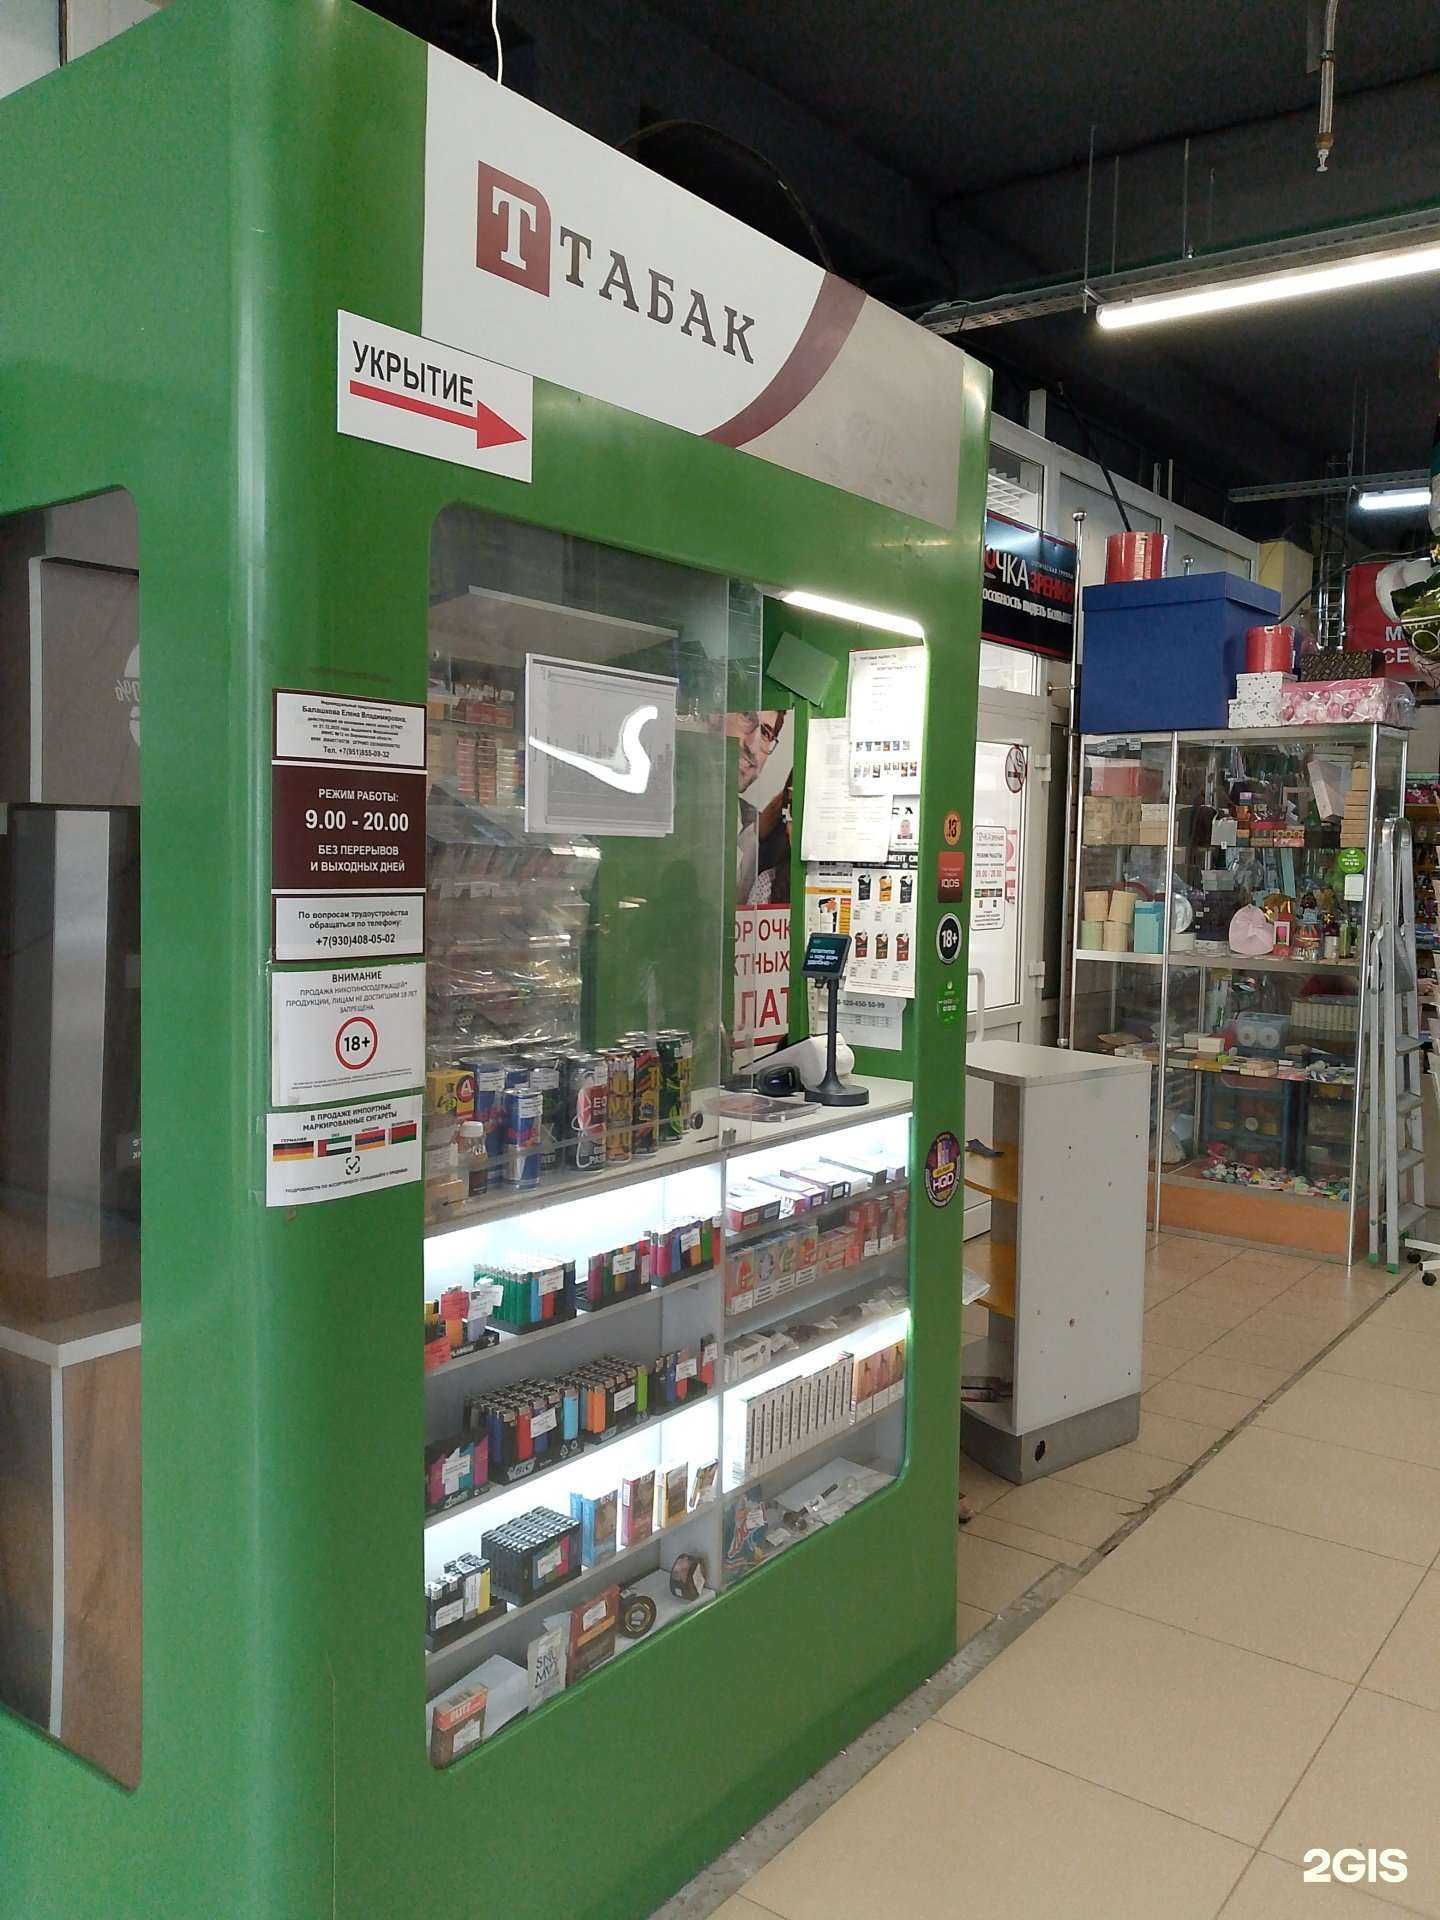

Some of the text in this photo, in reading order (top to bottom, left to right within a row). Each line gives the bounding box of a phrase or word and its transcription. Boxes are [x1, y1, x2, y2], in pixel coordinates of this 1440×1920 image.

[559, 225, 755, 365] ТАБАК
[352, 340, 475, 408] УКРЫТИЕ
[318, 789, 399, 802] РЕЖИМ РАБОТЫ:
[305, 810, 346, 830] 9.00
[363, 812, 409, 831] 20.00
[318, 845, 399, 855] БЕЗ ПЕРЕРЫВОВ
[310, 860, 405, 872] И ВЫХОДНЫХ ДНЕЙ
[941, 878, 960, 888] IQOS
[298, 908, 409, 920] По вопросам трудоустройства
[309, 921, 356, 930] обращаться
[315, 933, 396, 948] +7(930)408-05-02
[942, 929, 958, 948] 18+
[332, 970, 382, 984] ВНИМАНИЕ
[300, 987, 334, 997] ПРОДАЖА
[344, 1035, 371, 1052] 18+
[310, 1103, 392, 1122] В ПРОДАЖЕ ИМПОРТНЫЕ
[303, 1111, 397, 1131] МАРКИРОВАННЫЕ СИГАРЕТЫ
